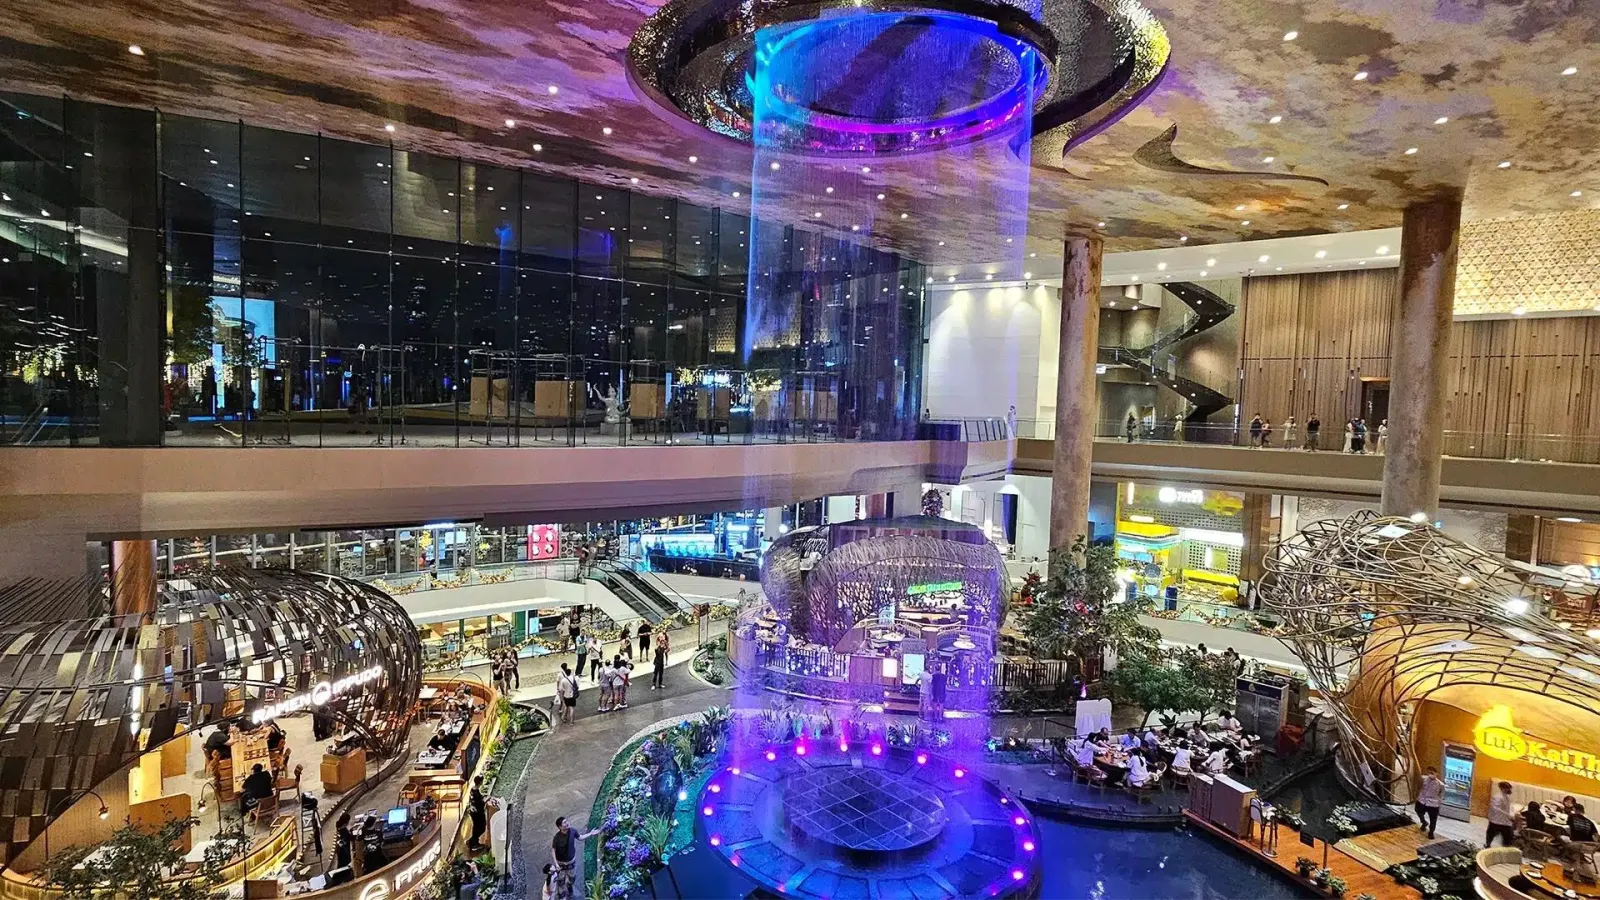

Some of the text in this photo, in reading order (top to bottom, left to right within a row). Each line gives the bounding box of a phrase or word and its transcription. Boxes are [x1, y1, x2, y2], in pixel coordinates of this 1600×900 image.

[252, 665, 382, 724] RAMEN IPPUDO
[1483, 731, 1520, 753] Luk
